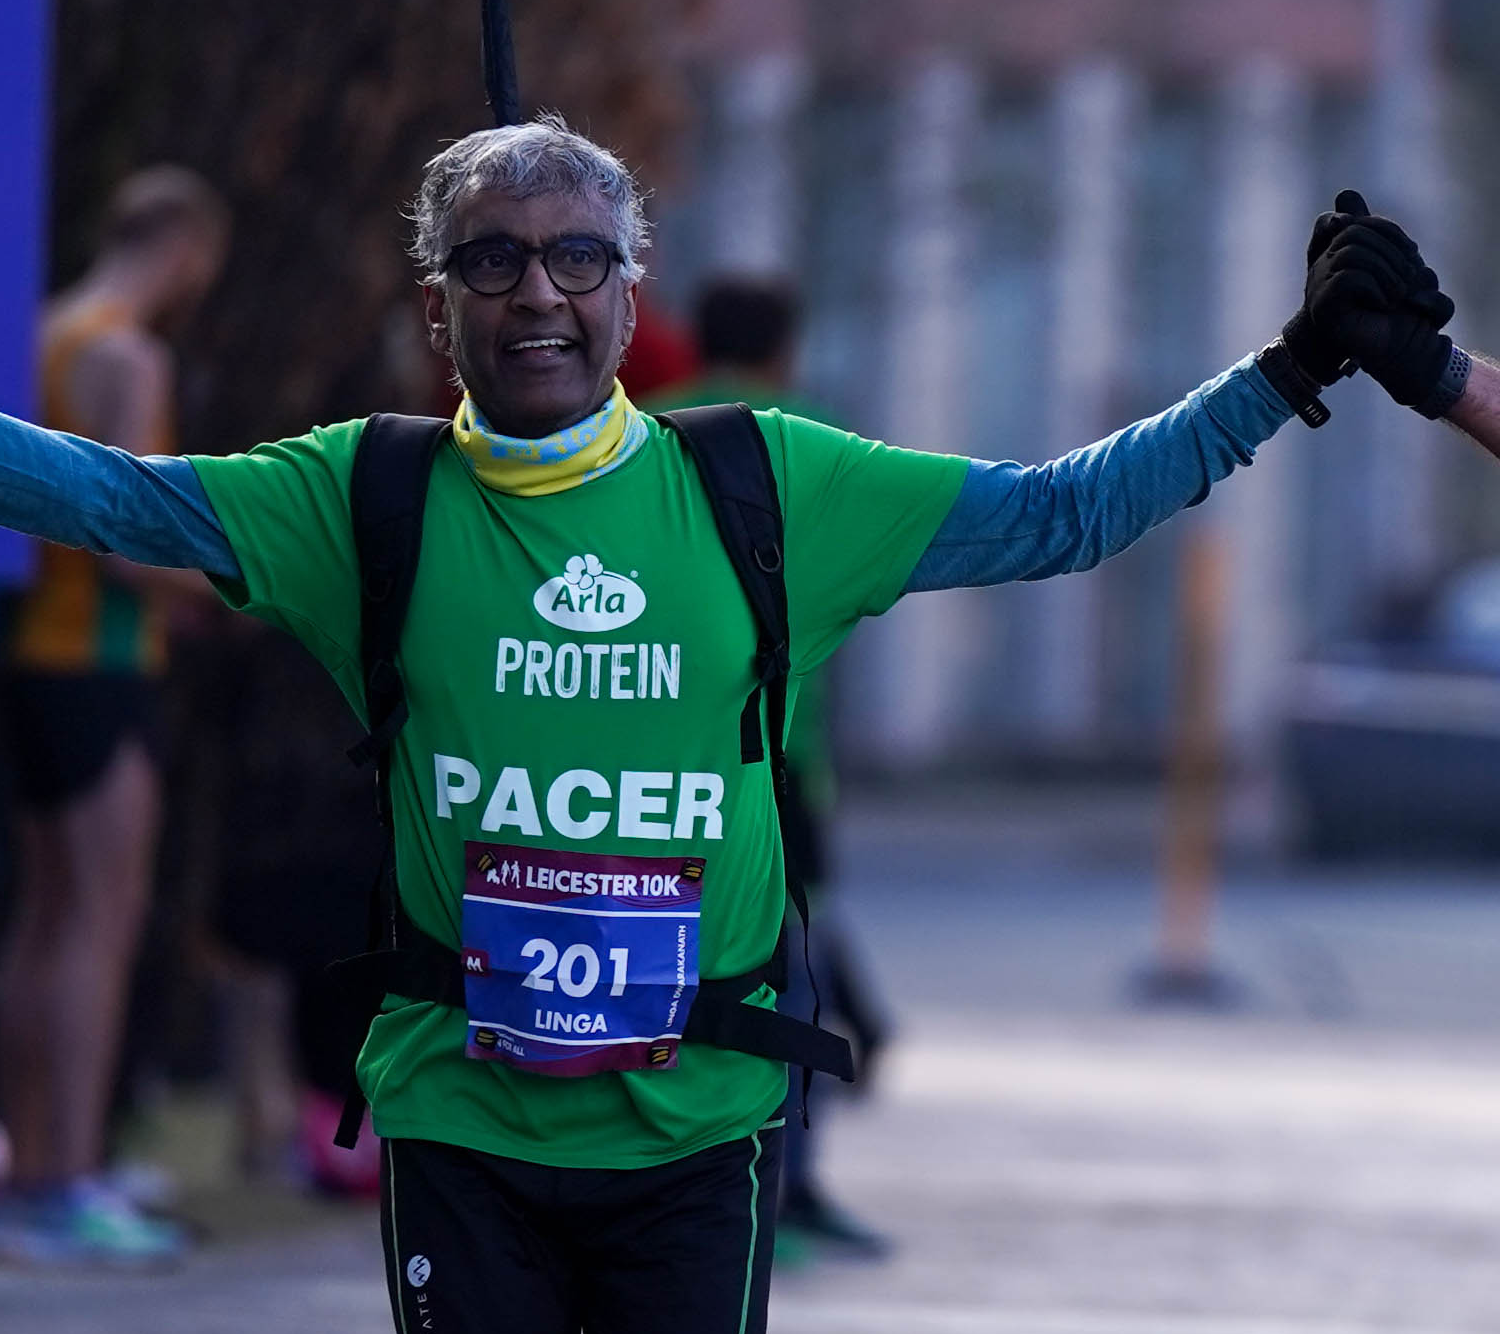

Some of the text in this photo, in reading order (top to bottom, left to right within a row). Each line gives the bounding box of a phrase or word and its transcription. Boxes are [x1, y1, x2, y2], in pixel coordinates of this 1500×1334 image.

[551, 584, 626, 614] Arla
[495, 637, 681, 700] PROTEIN
[433, 753, 725, 841] PACER
[526, 865, 681, 897] LEICESTER 10K
[520, 937, 629, 998] 201
[534, 1008, 608, 1034] LINGA
